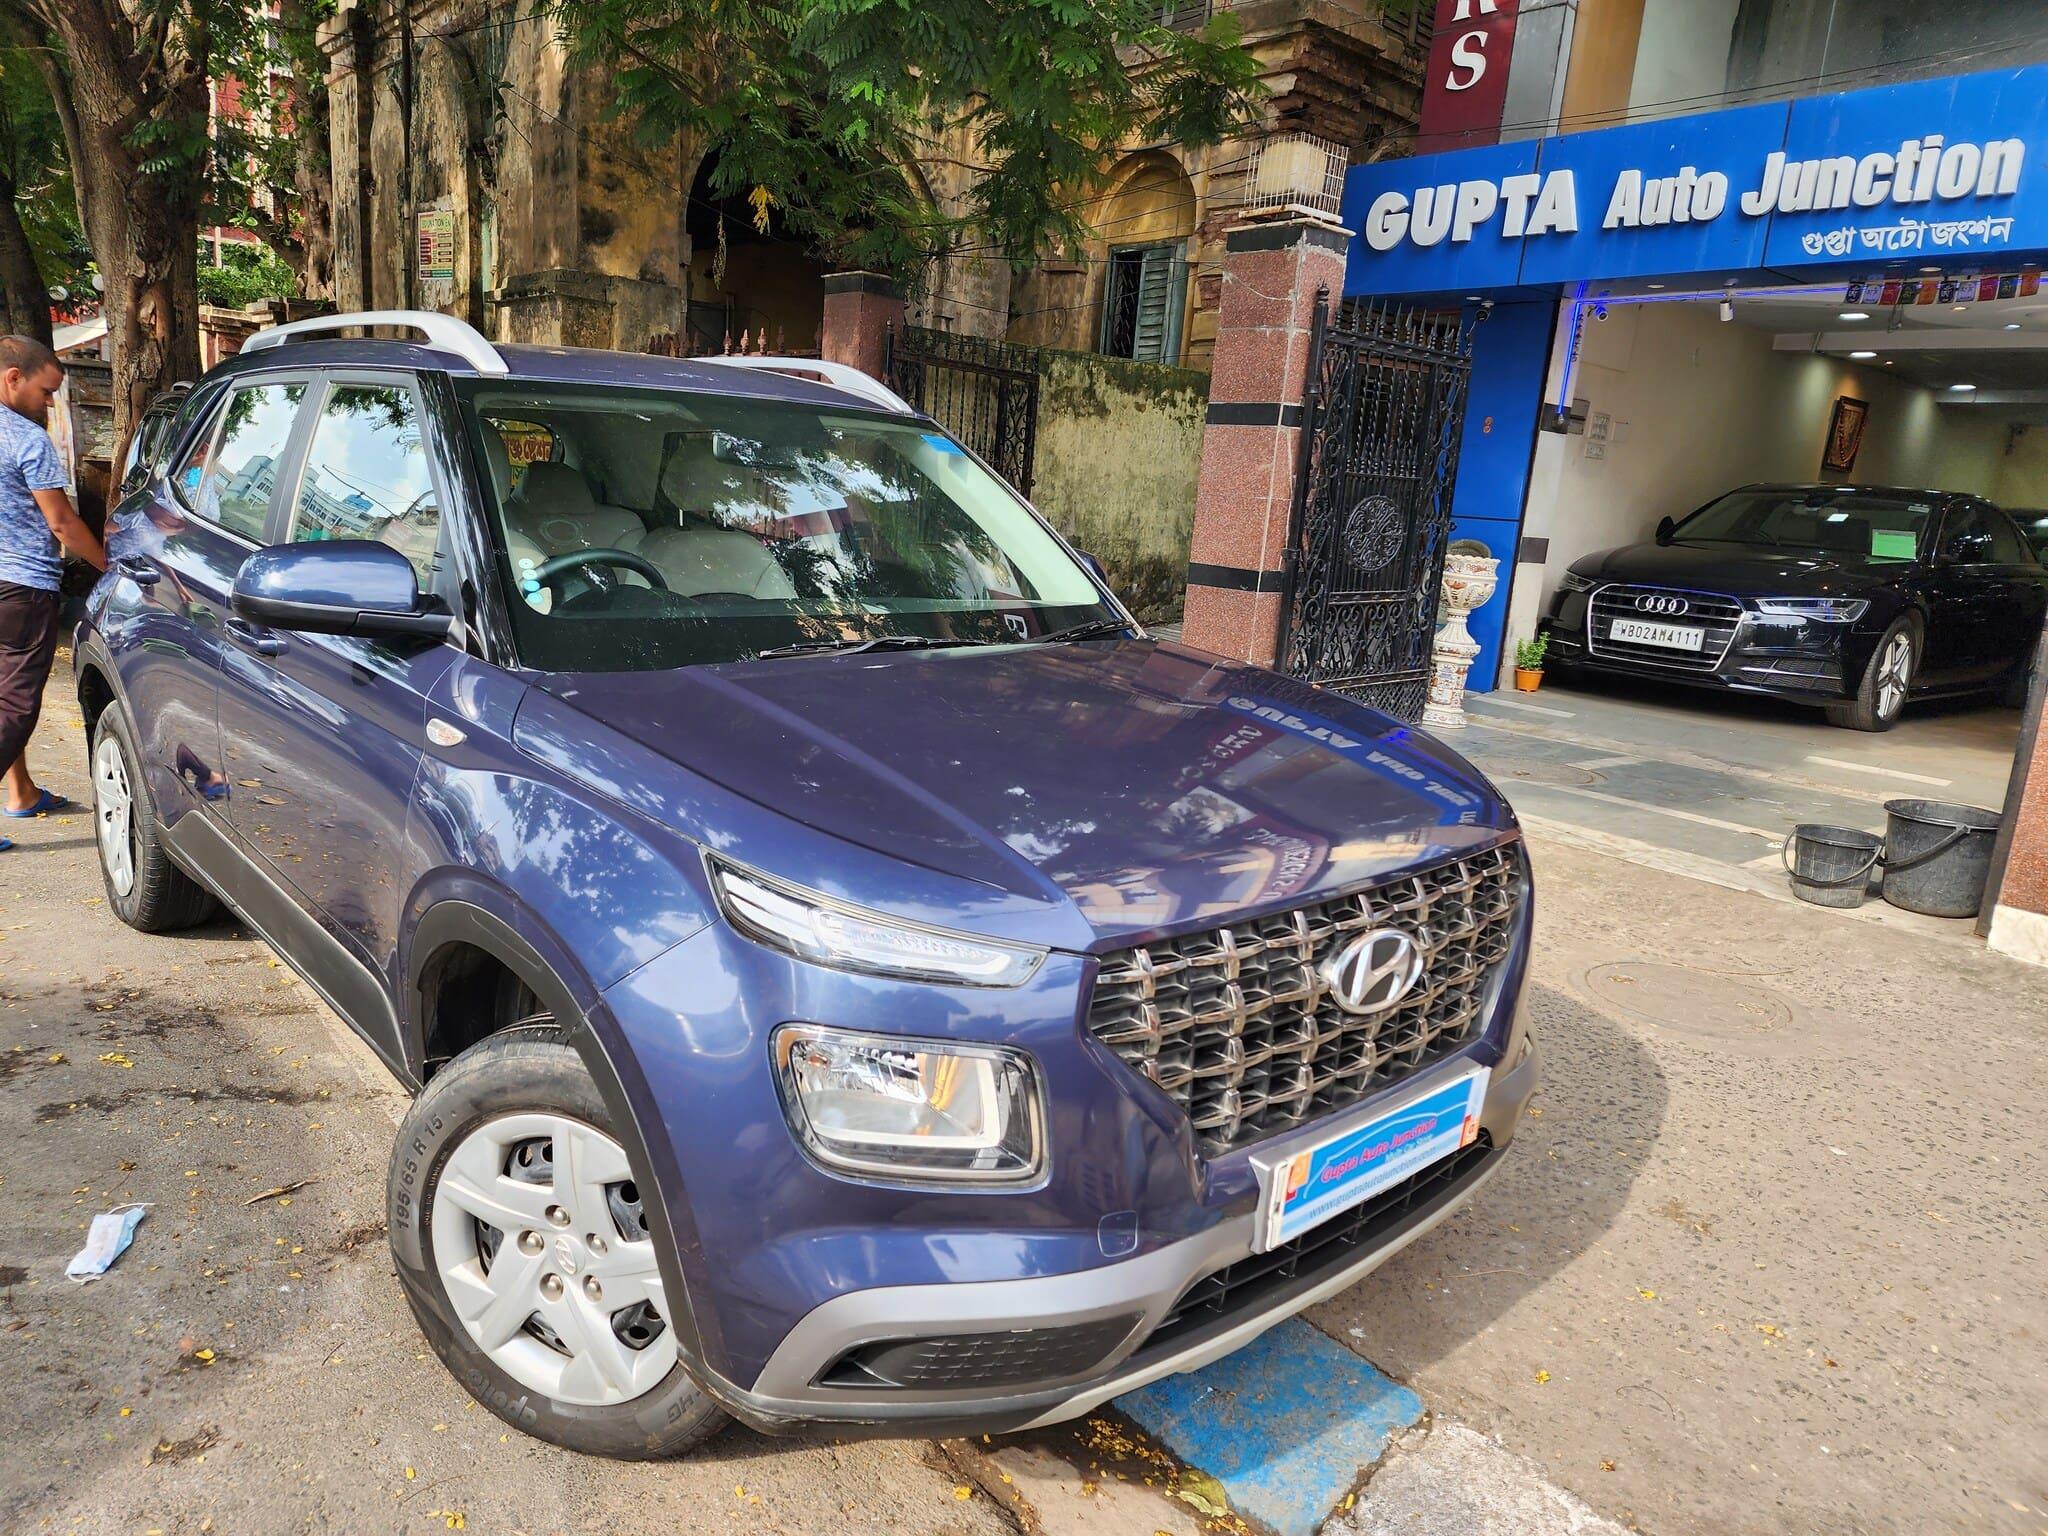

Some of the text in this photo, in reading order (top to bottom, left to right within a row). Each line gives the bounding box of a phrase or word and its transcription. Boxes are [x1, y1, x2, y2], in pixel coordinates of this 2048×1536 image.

[1365, 134, 2025, 251] GUPTA Auto Junction
[1802, 215, 2015, 256] গুপ্তা অটো জংশন
[396, 1158, 418, 1229] 195/65
[412, 1136, 427, 1155] R
[424, 1113, 443, 1136] 15
[1321, 1156, 1358, 1183] Gupta
[1359, 1141, 1389, 1165] Auto
[1391, 1118, 1437, 1147] Junction
